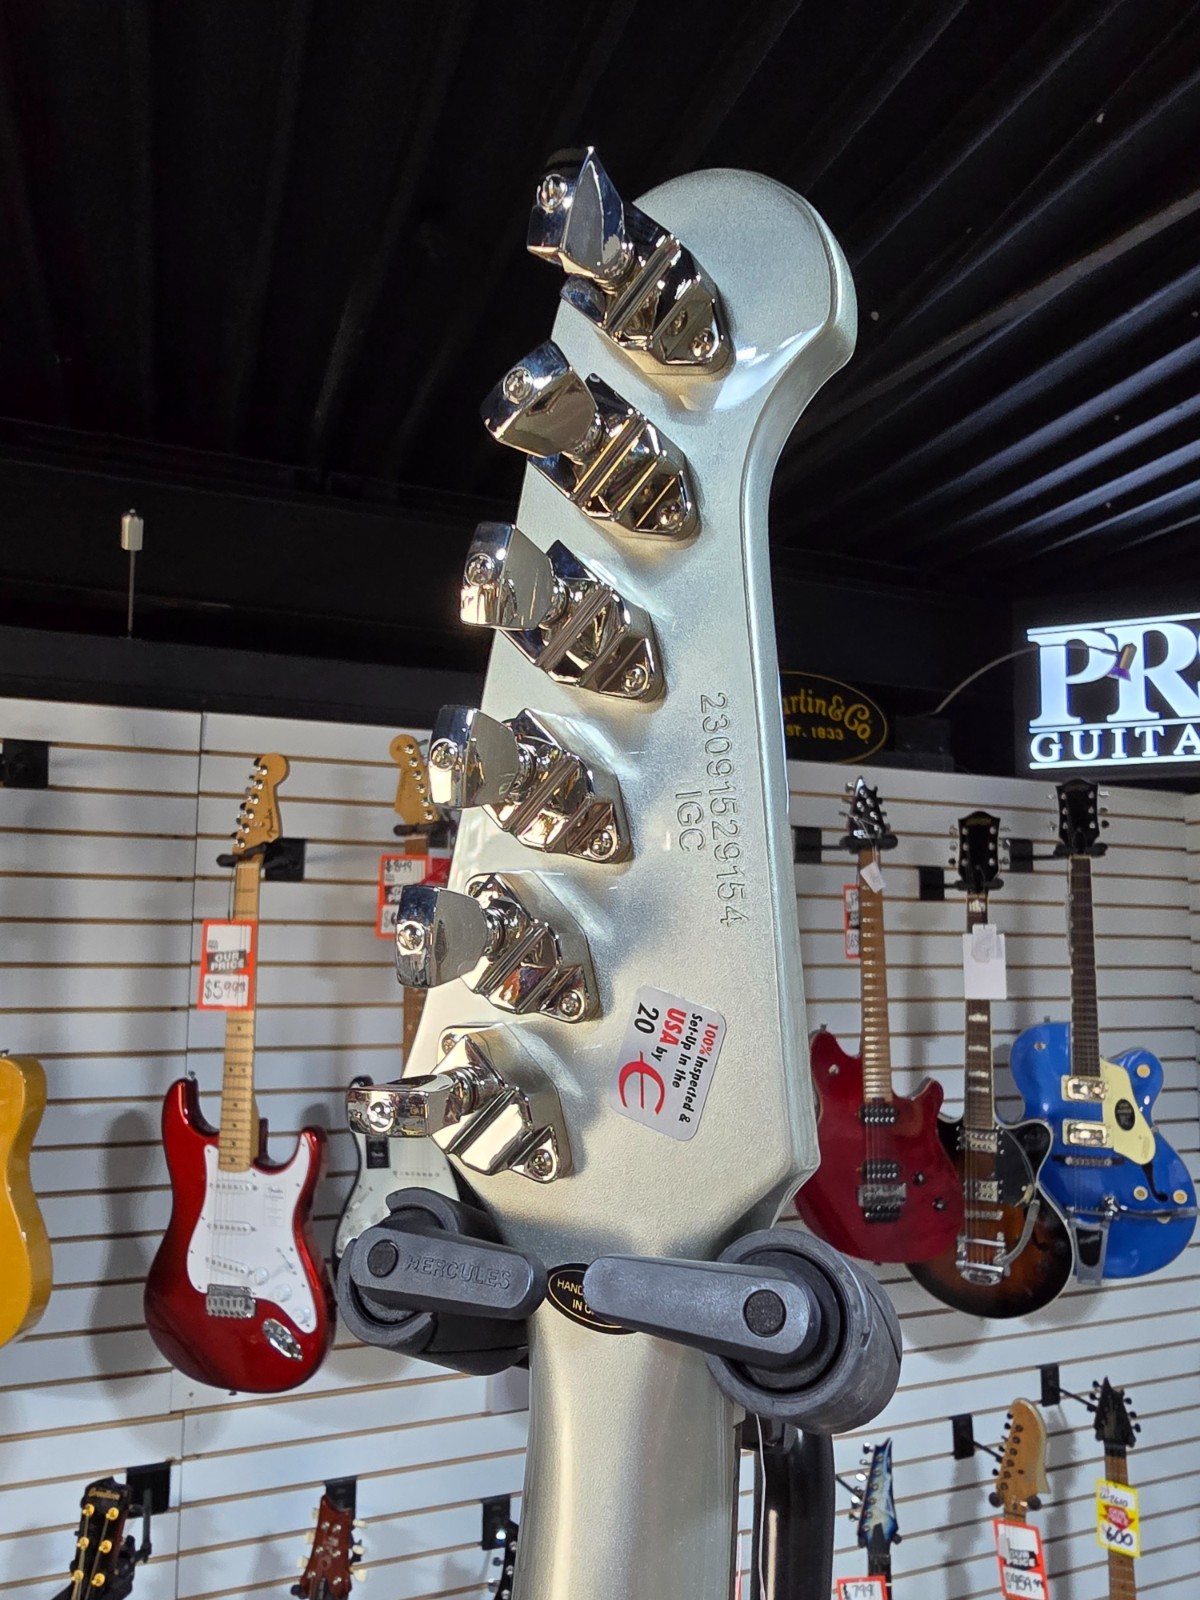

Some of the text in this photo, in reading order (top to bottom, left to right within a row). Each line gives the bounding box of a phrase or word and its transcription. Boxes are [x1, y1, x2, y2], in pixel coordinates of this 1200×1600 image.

[1027, 622, 1200, 727] PR
[785, 724, 845, 741] ST. 1833
[675, 790, 707, 852] IGC
[700, 692, 750, 928] 23091529154
[634, 1002, 660, 1034] 20
[651, 1007, 687, 1062] USA by
[672, 1013, 703, 1089] Set-Up In the
[678, 1023, 719, 1124] 100% Inspected &
[404, 1256, 513, 1290] HERCULES
[572, 1299, 583, 1311] IN
